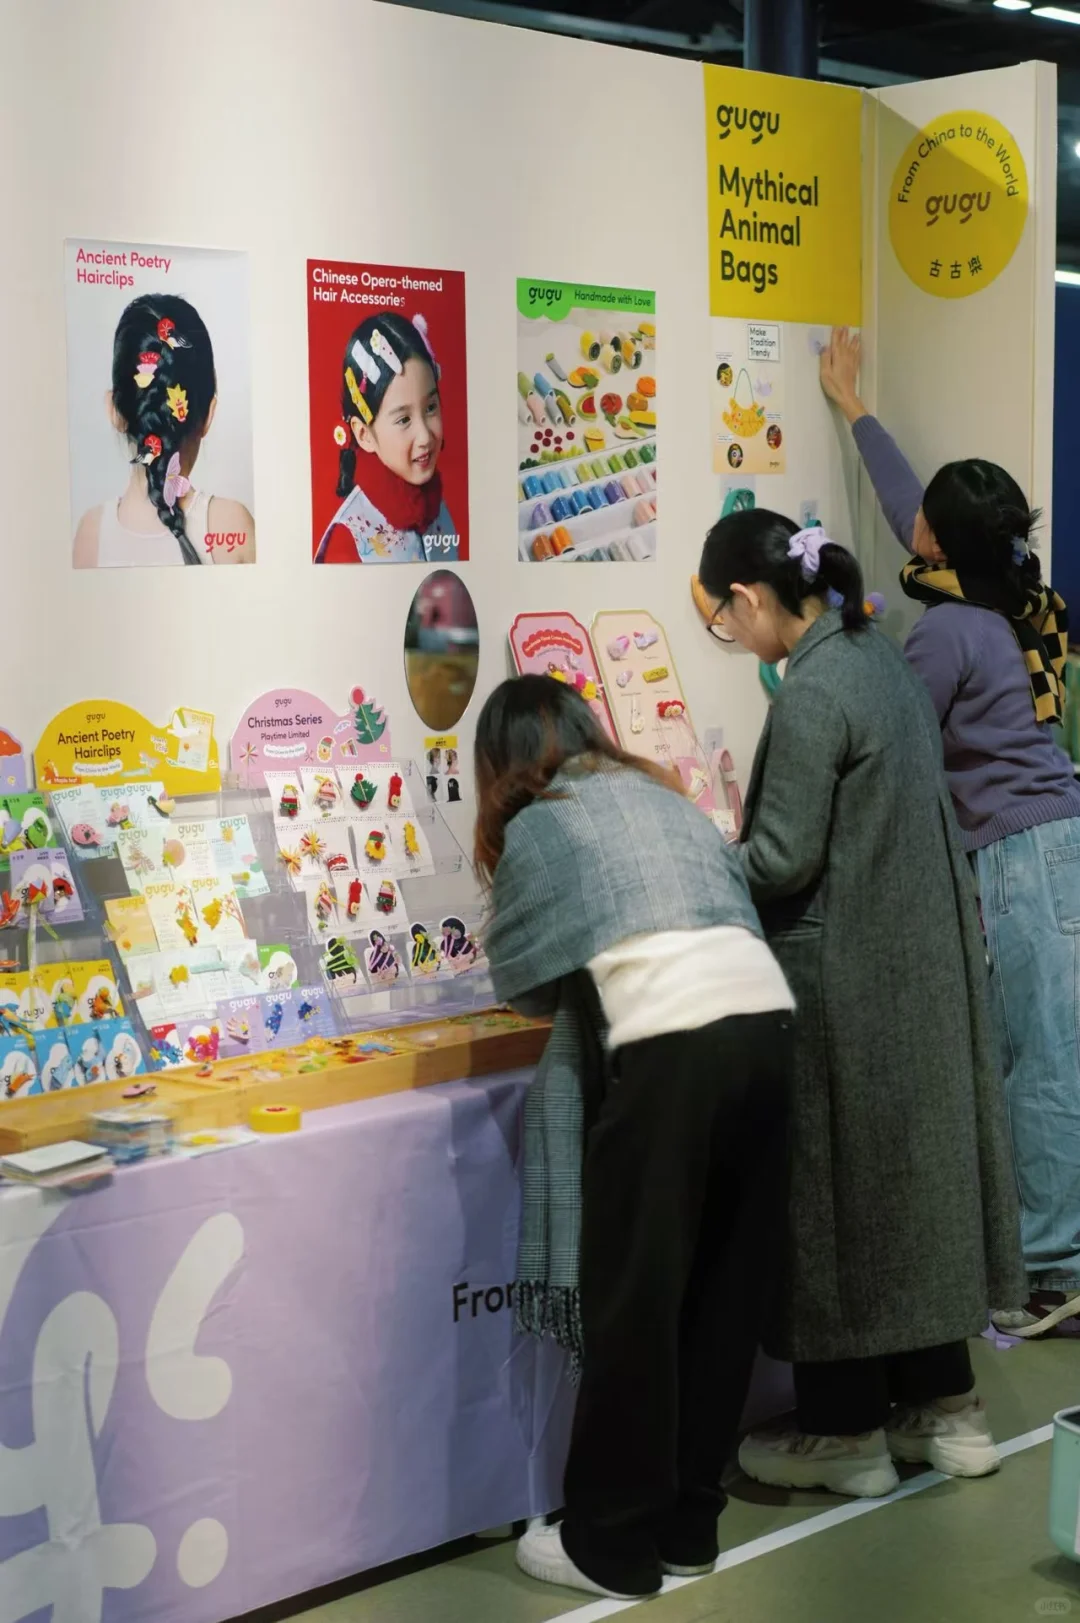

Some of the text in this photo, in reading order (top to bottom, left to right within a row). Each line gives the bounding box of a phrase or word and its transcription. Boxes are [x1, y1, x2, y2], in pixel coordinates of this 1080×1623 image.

[716, 104, 780, 145] gugu
[898, 124, 1019, 203] From China to the World
[719, 164, 819, 208] Mythical
[925, 191, 991, 226] gugu
[719, 209, 801, 247] Animal
[76, 248, 171, 274] Ancient Poetry
[77, 268, 134, 290] Hairclips
[312, 268, 443, 292] Chinese Opera-themed
[720, 250, 779, 294] Bags
[313, 287, 405, 307] Hair Accessories
[528, 287, 562, 306] gugu
[574, 291, 651, 306] Handmade with Love
[749, 327, 766, 337] Make
[749, 337, 776, 347] Tradition
[750, 347, 770, 358] Trendy
[204, 532, 246, 552] gugu
[424, 533, 460, 554] gugu
[275, 698, 292, 708] gugu
[86, 713, 106, 723] gugu
[247, 714, 323, 729] Christmas Series
[58, 729, 135, 745] Ancient Poetry
[261, 730, 310, 742] Playtime Limited
[74, 745, 121, 759] Hairclips
[178, 823, 205, 838] gugu
[220, 816, 247, 831] gugu
[118, 828, 148, 845] gugu
[145, 883, 175, 898] gugu
[191, 877, 220, 892] gugu
[265, 990, 292, 1006] gugu
[302, 986, 325, 1003] gugu
[229, 997, 257, 1013] gugu
